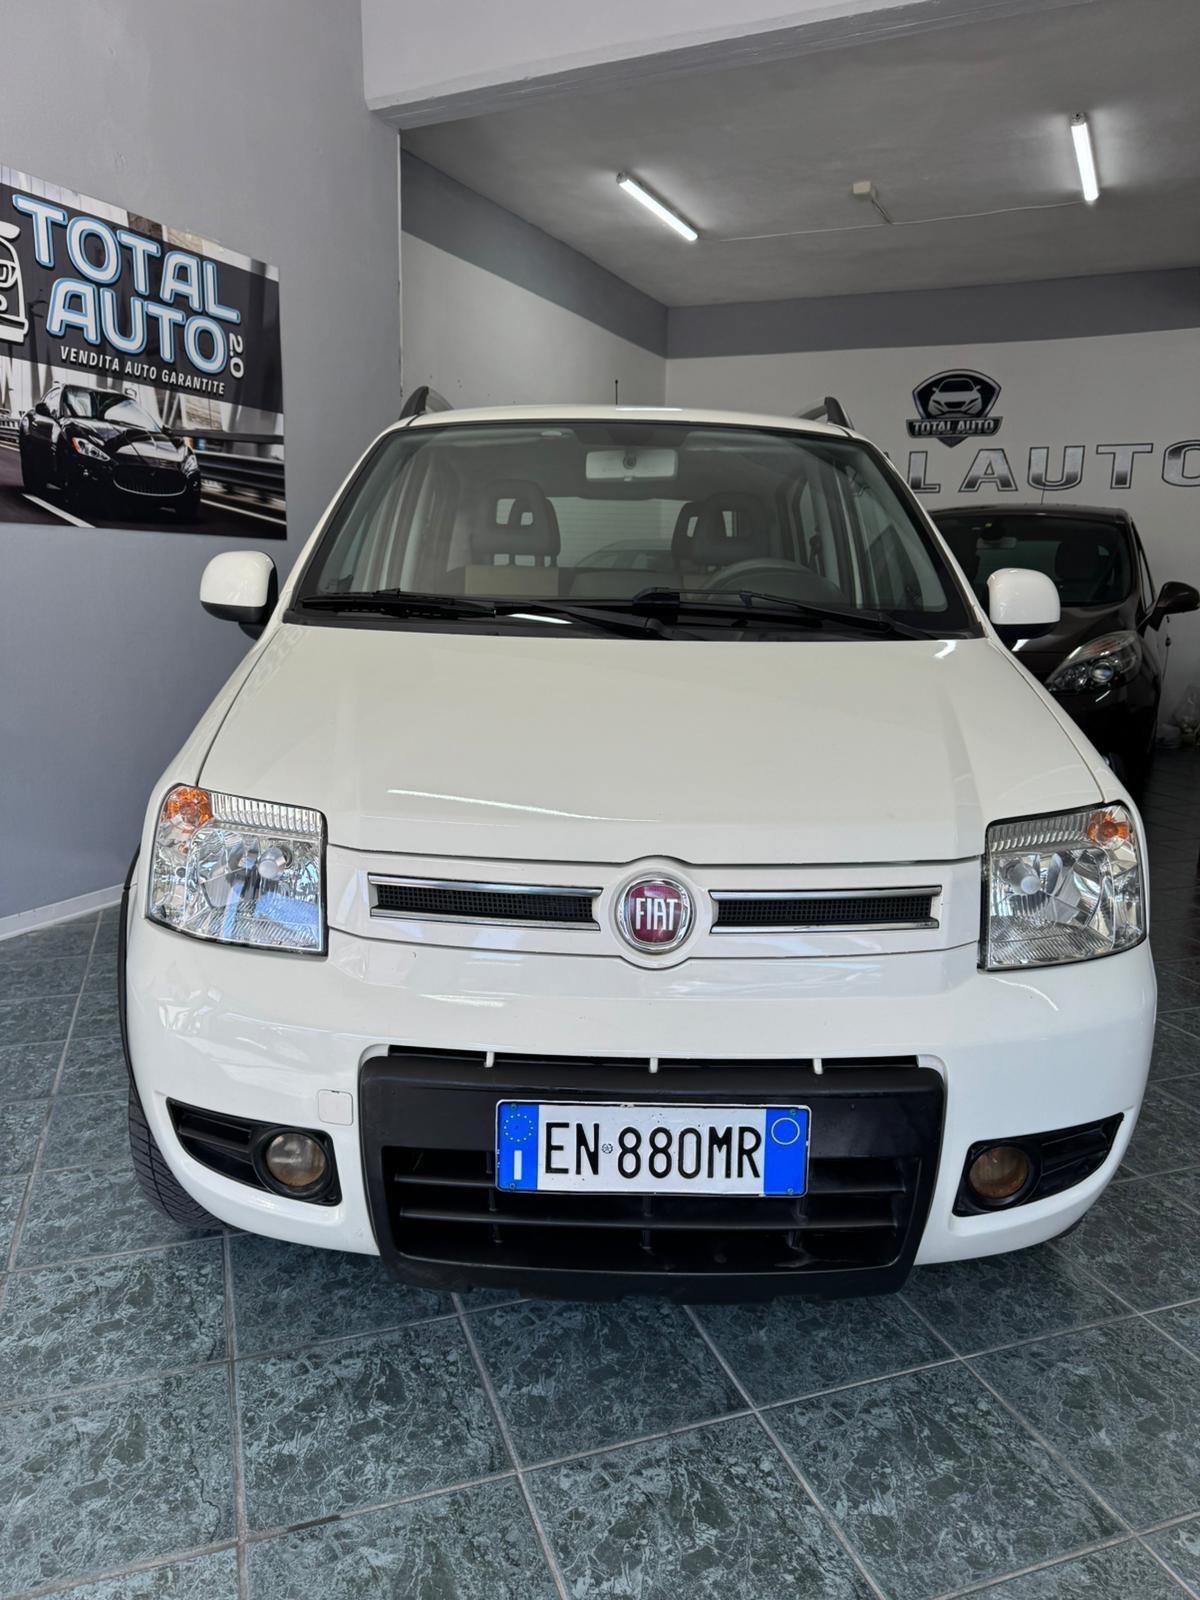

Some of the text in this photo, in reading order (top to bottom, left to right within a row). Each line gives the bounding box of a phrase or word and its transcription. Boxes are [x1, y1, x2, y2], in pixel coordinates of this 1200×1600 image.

[12, 194, 241, 324] TOTAL
[46, 277, 228, 375] AUTO
[60, 345, 226, 396] VENDITA AUTO GARANTITE
[229, 332, 244, 379] 2.0
[913, 419, 995, 435] TOTAL AUTO
[958, 439, 1200, 493] AUTO
[635, 897, 679, 931] FIAT
